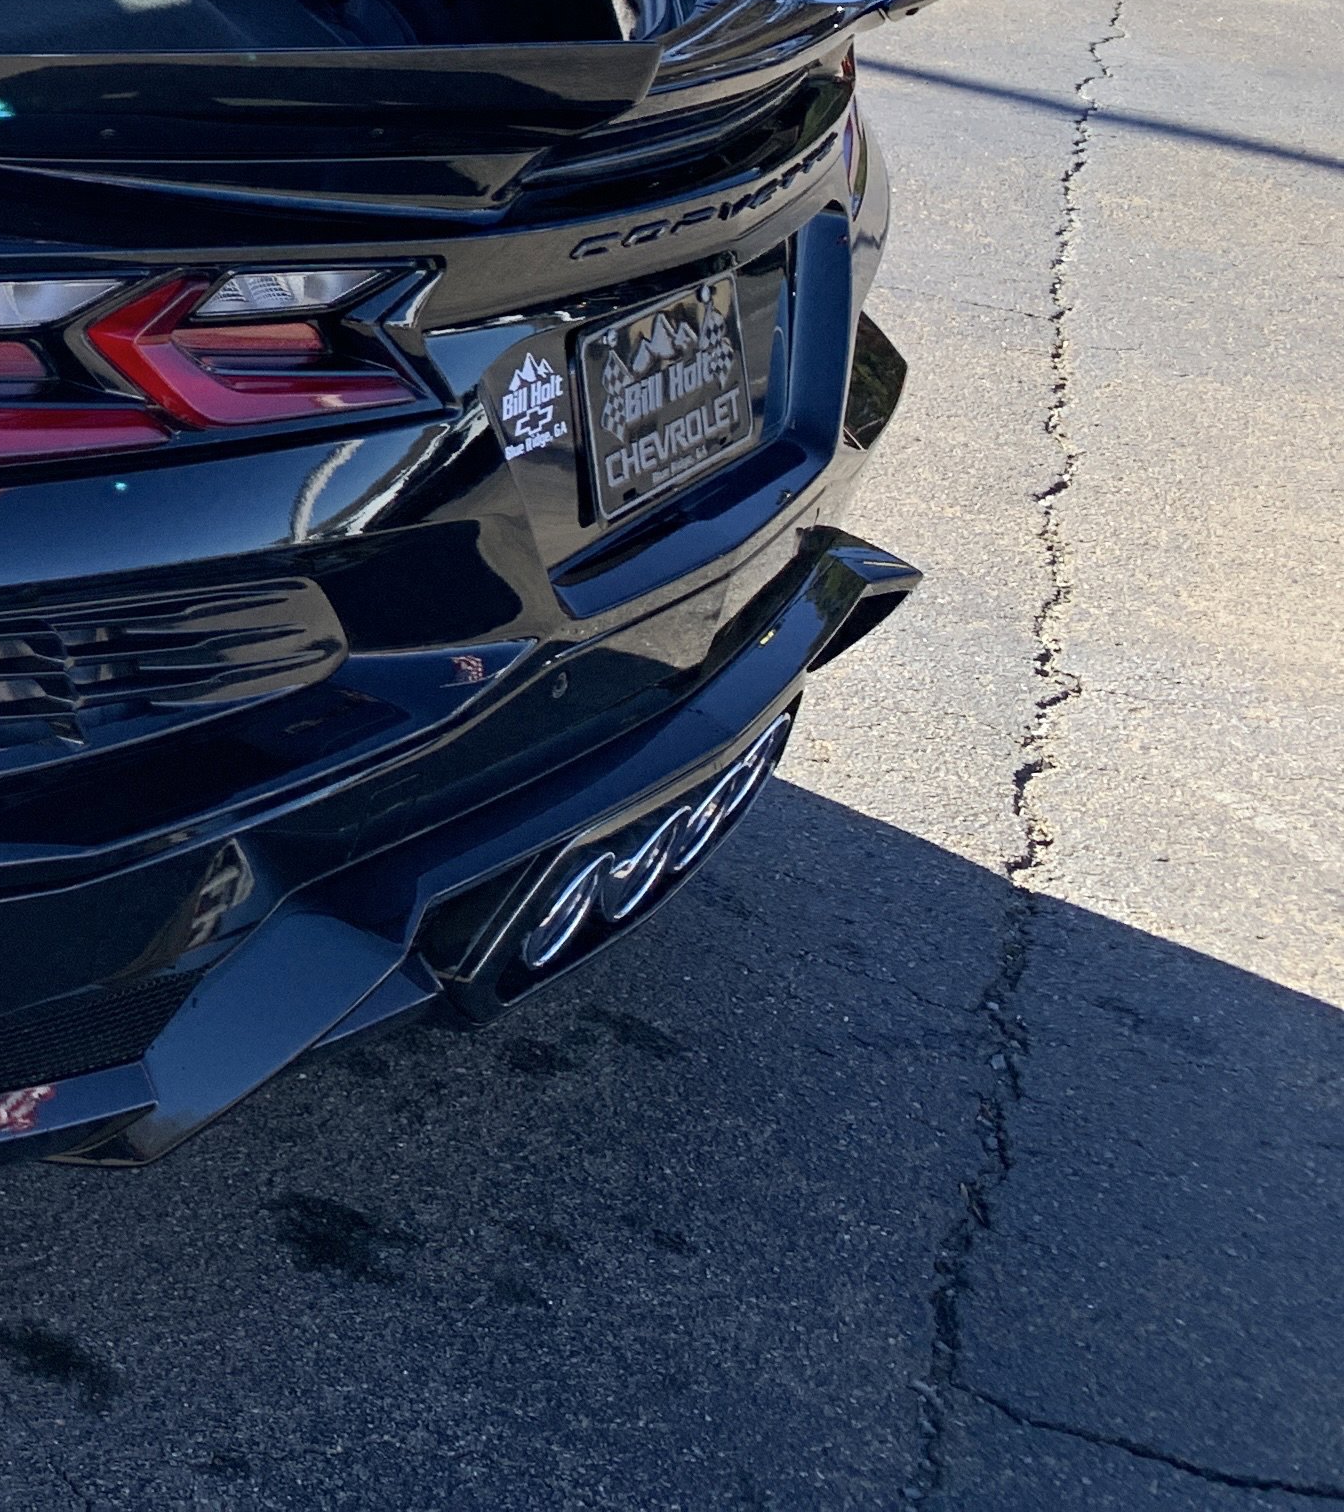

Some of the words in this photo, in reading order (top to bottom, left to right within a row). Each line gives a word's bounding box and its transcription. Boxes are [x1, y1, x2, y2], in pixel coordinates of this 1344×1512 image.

[569, 131, 839, 260] CORVETTE
[502, 387, 528, 422] Bill
[530, 374, 564, 408] Holt
[624, 372, 663, 423] Bill
[667, 350, 714, 402] Holt
[553, 420, 568, 438] GA
[605, 387, 740, 488] CHEVROLET
